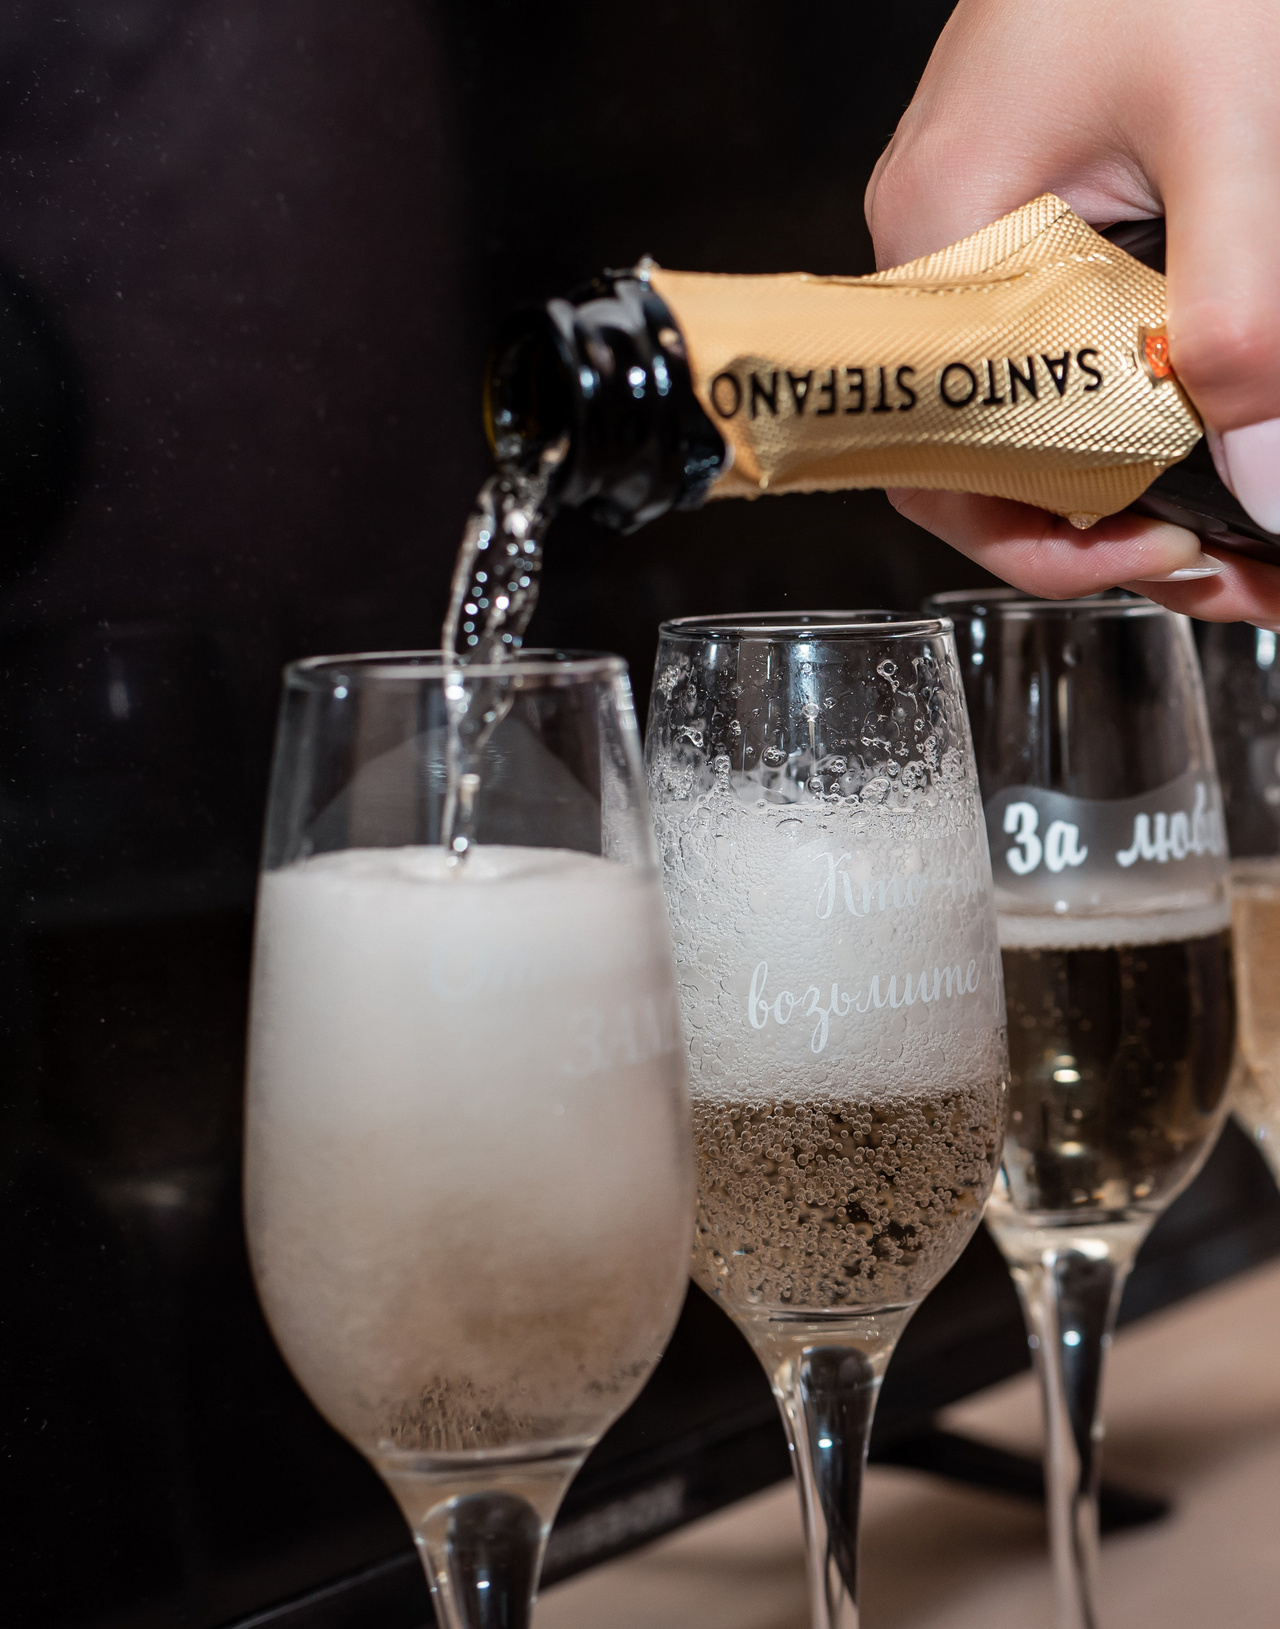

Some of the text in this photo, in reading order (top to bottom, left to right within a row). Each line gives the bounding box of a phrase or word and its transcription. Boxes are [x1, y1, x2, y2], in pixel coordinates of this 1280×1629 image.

[710, 347, 1103, 420] SANTO STEFANO
[1003, 801, 1088, 876] За
[748, 958, 981, 1054] возьмите
